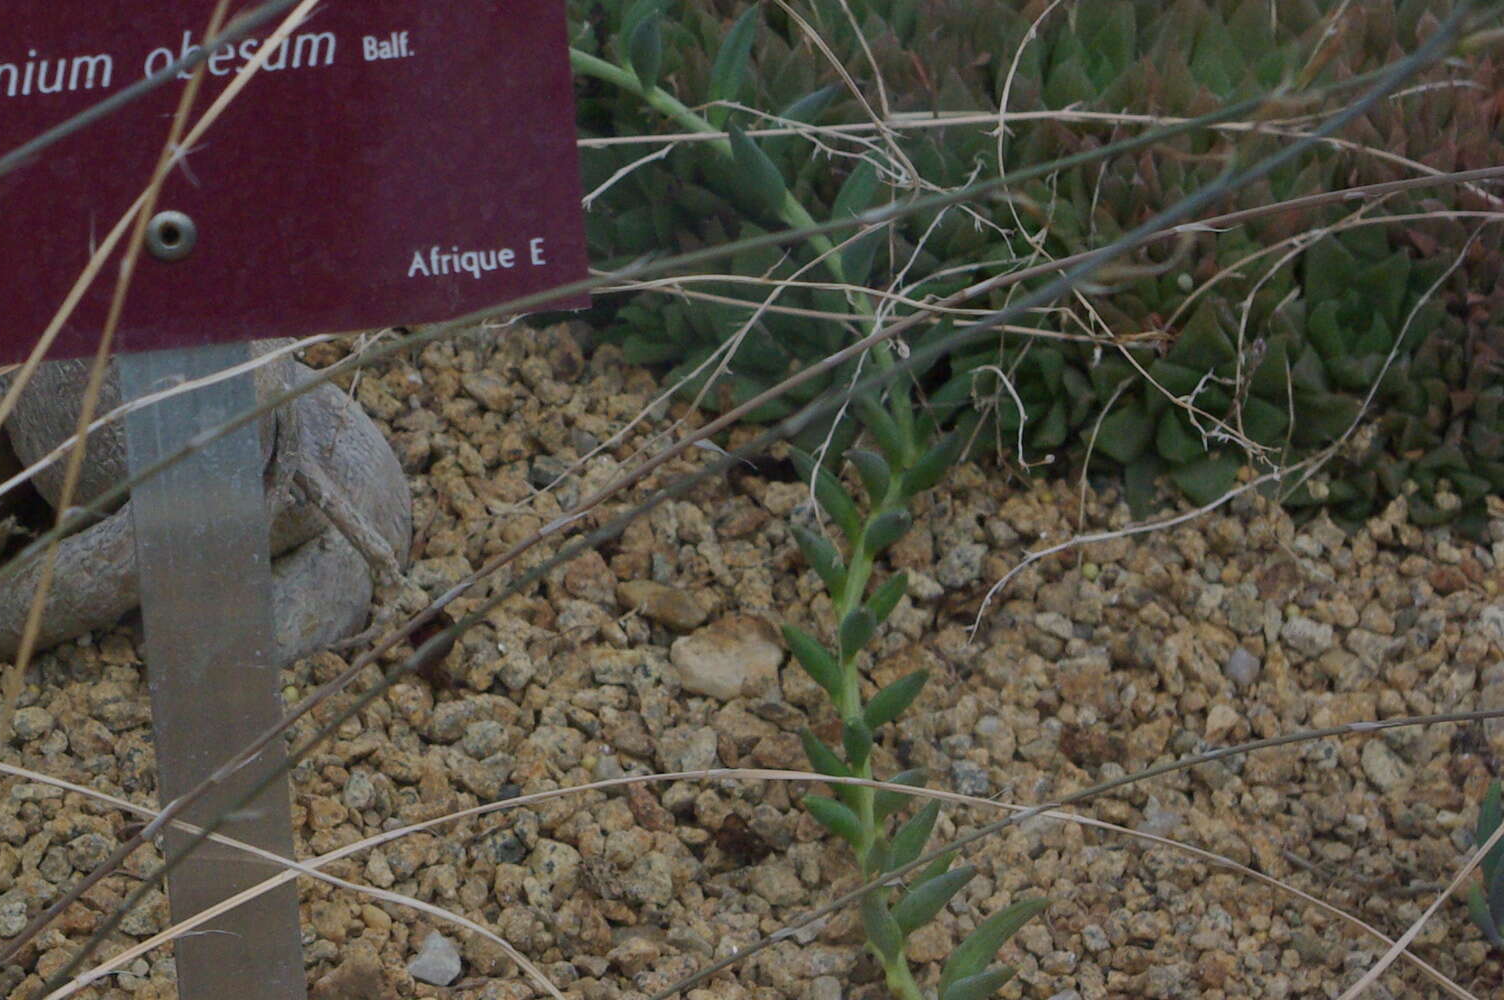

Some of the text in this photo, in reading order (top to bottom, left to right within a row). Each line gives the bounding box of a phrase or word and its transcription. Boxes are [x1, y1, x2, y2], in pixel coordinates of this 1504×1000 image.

[362, 31, 415, 62] Balf.
[407, 237, 547, 280] Afrique E
